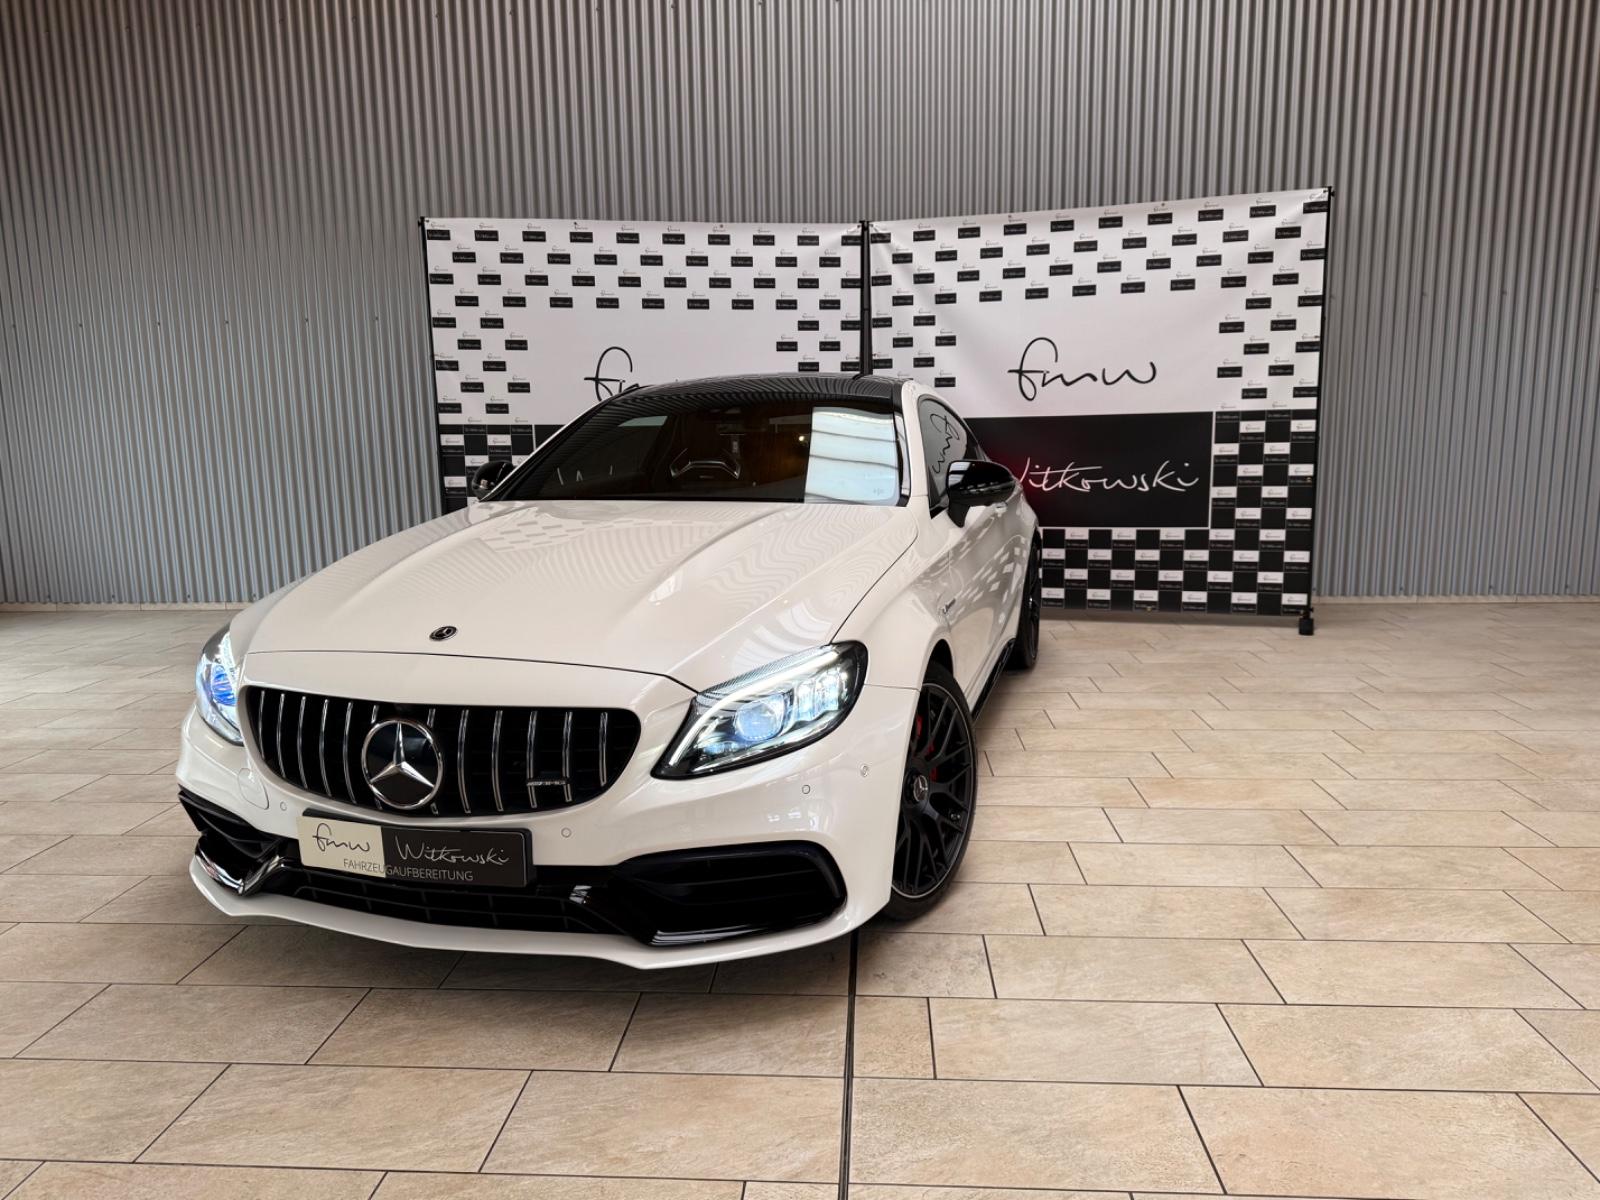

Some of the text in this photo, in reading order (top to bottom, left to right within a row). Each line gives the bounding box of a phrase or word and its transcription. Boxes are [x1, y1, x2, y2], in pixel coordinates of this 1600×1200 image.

[1007, 337, 1157, 402] fmw
[312, 822, 509, 866] fmw Witkowski
[343, 858, 474, 882] FAHRZEUGAUFBEREITUNG
